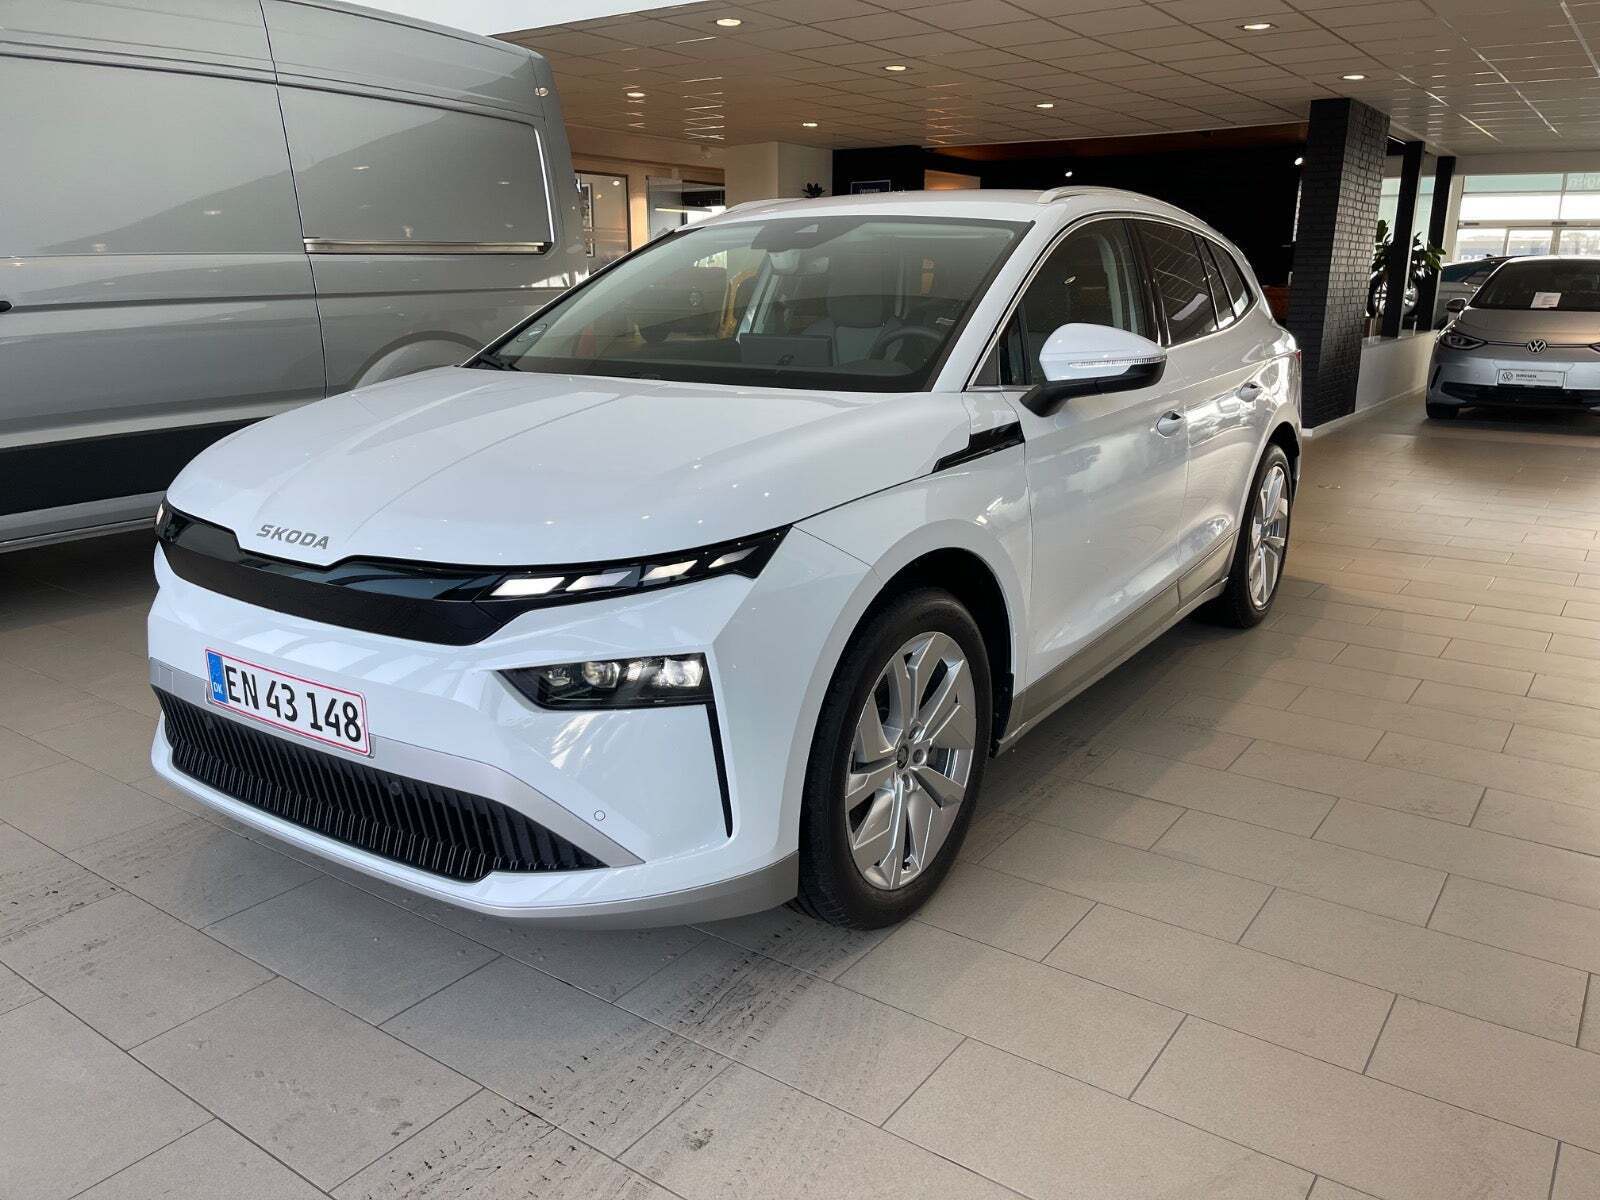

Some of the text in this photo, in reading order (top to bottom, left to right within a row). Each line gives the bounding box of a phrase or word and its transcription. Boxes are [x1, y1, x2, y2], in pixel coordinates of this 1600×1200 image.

[212, 681, 223, 696] DK
[224, 664, 362, 743] EN 43 148
